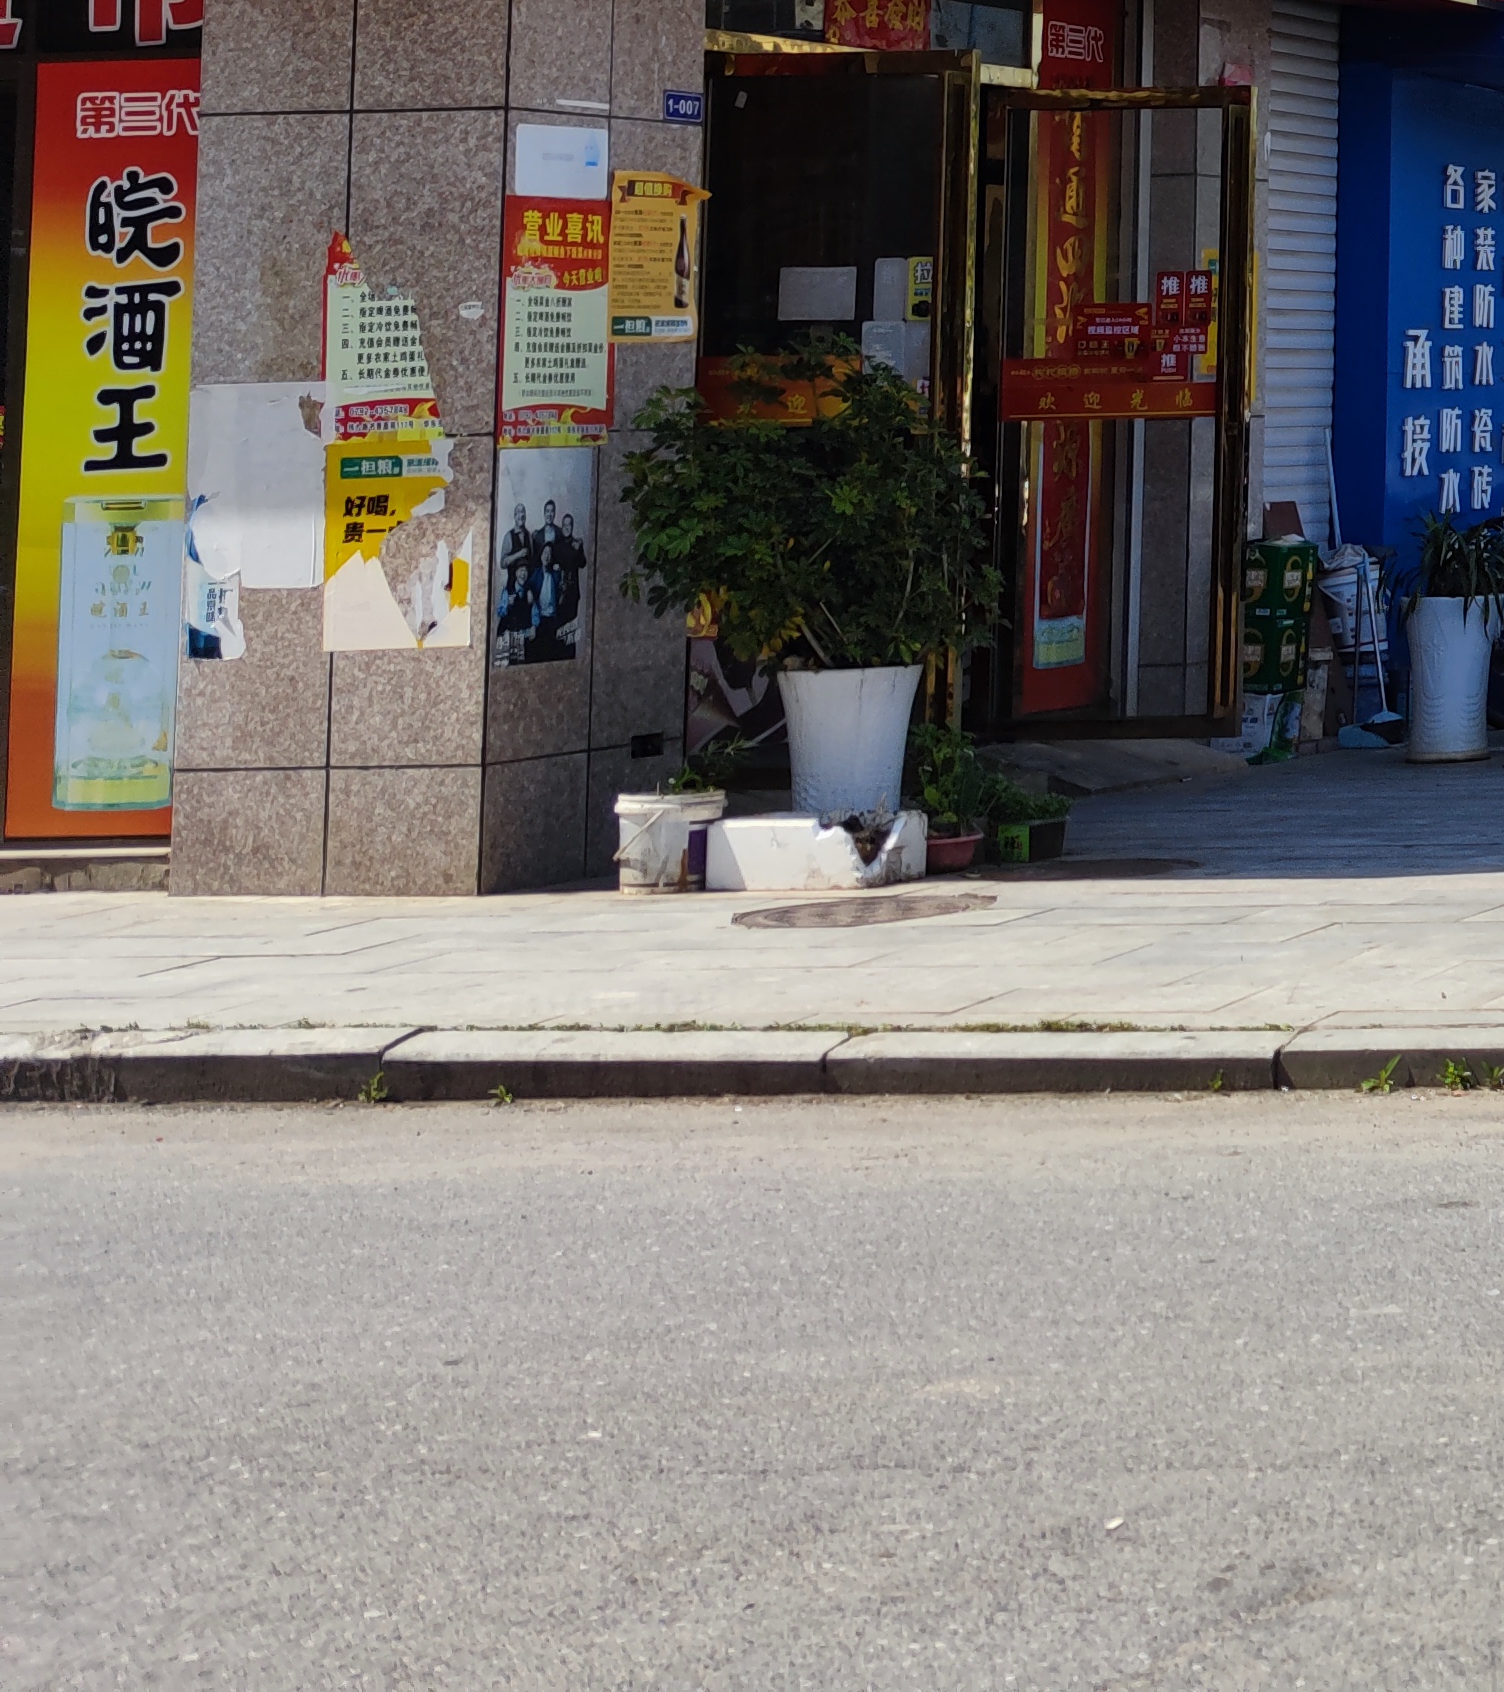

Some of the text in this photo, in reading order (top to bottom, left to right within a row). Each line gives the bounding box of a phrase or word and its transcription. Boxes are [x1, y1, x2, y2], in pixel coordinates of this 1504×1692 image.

[1048, 20, 1103, 63] 第三代
[75, 91, 200, 139] 第三代
[668, 98, 699, 115] 1-007
[523, 210, 605, 244] 营业喜讯
[914, 262, 933, 283] 拉
[1160, 276, 1180, 295] 推
[1188, 275, 1208, 295] 推
[83, 167, 186, 474] 皖酒王
[1439, 163, 1465, 514] 各种建筑防水
[1471, 169, 1496, 510] 家装防水瓷砖
[1160, 353, 1176, 366] 推
[1038, 388, 1192, 411] 欢迎光临
[1403, 329, 1432, 476] 承接
